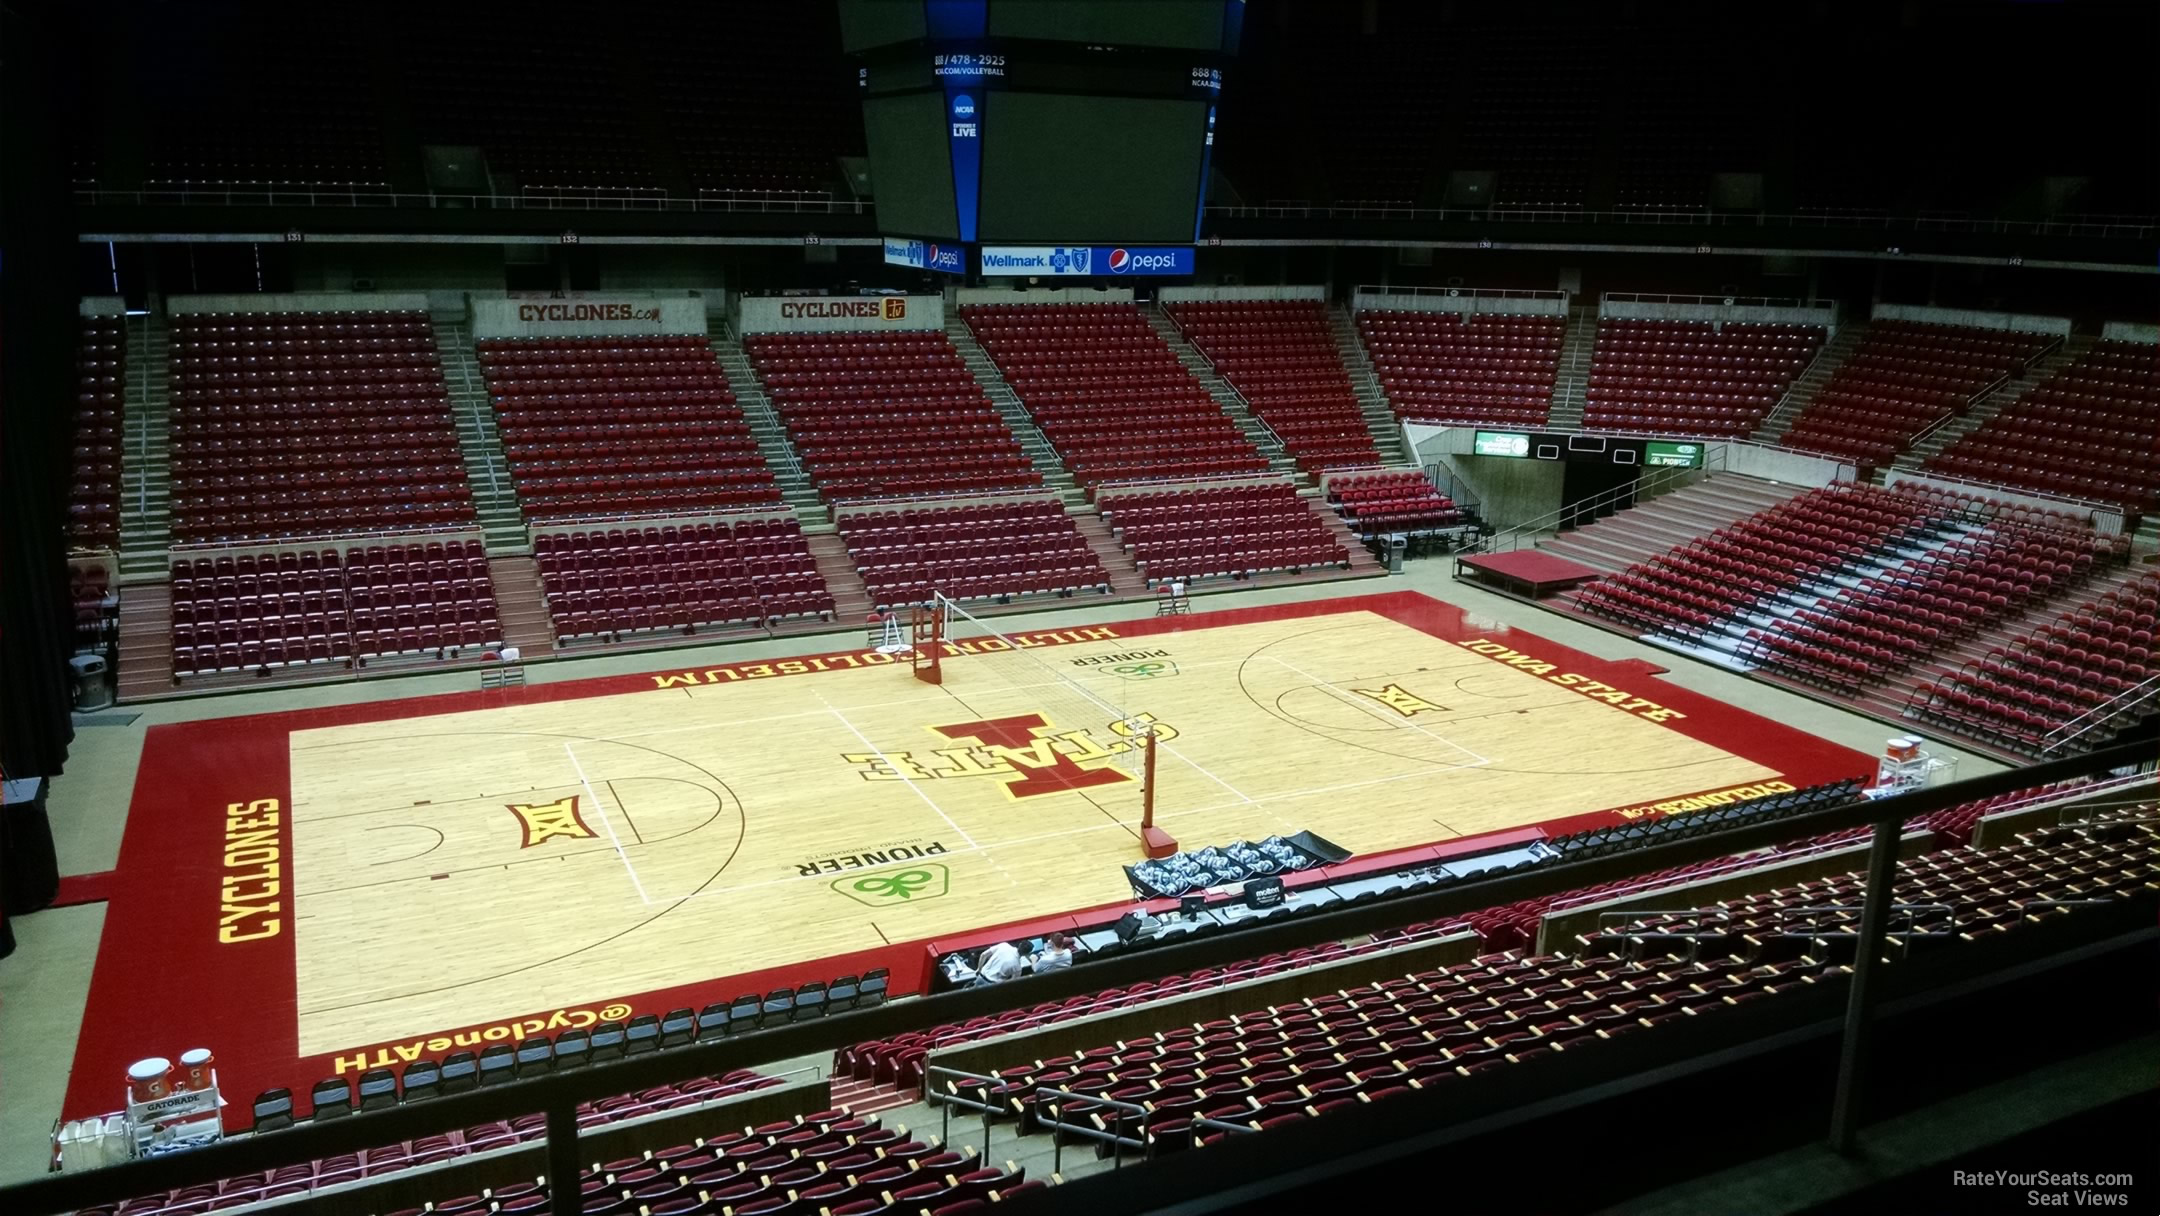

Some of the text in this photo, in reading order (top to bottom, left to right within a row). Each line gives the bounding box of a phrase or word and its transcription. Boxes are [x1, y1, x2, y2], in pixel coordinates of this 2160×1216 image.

[950, 54, 971, 65] 478
[978, 54, 1006, 66] 2925
[953, 128, 977, 137] LIVE
[286, 233, 302, 242] 131
[562, 236, 578, 245] 132
[805, 237, 819, 245] 133
[939, 251, 958, 268] pepsi
[982, 254, 1046, 267] Wellmark
[1132, 252, 1175, 271] pepsi
[2008, 257, 2022, 266] 142
[782, 302, 880, 318] CYCLONES
[941, 626, 1119, 657] HILTON
[1071, 649, 1172, 667] PIONEER
[1458, 638, 1688, 721] IOWA STATE
[794, 841, 951, 877] PIONEER
[219, 798, 280, 944] CYCLONES
[335, 1003, 632, 1075] @CycloneATH
[147, 1094, 201, 1111] GATORADE
